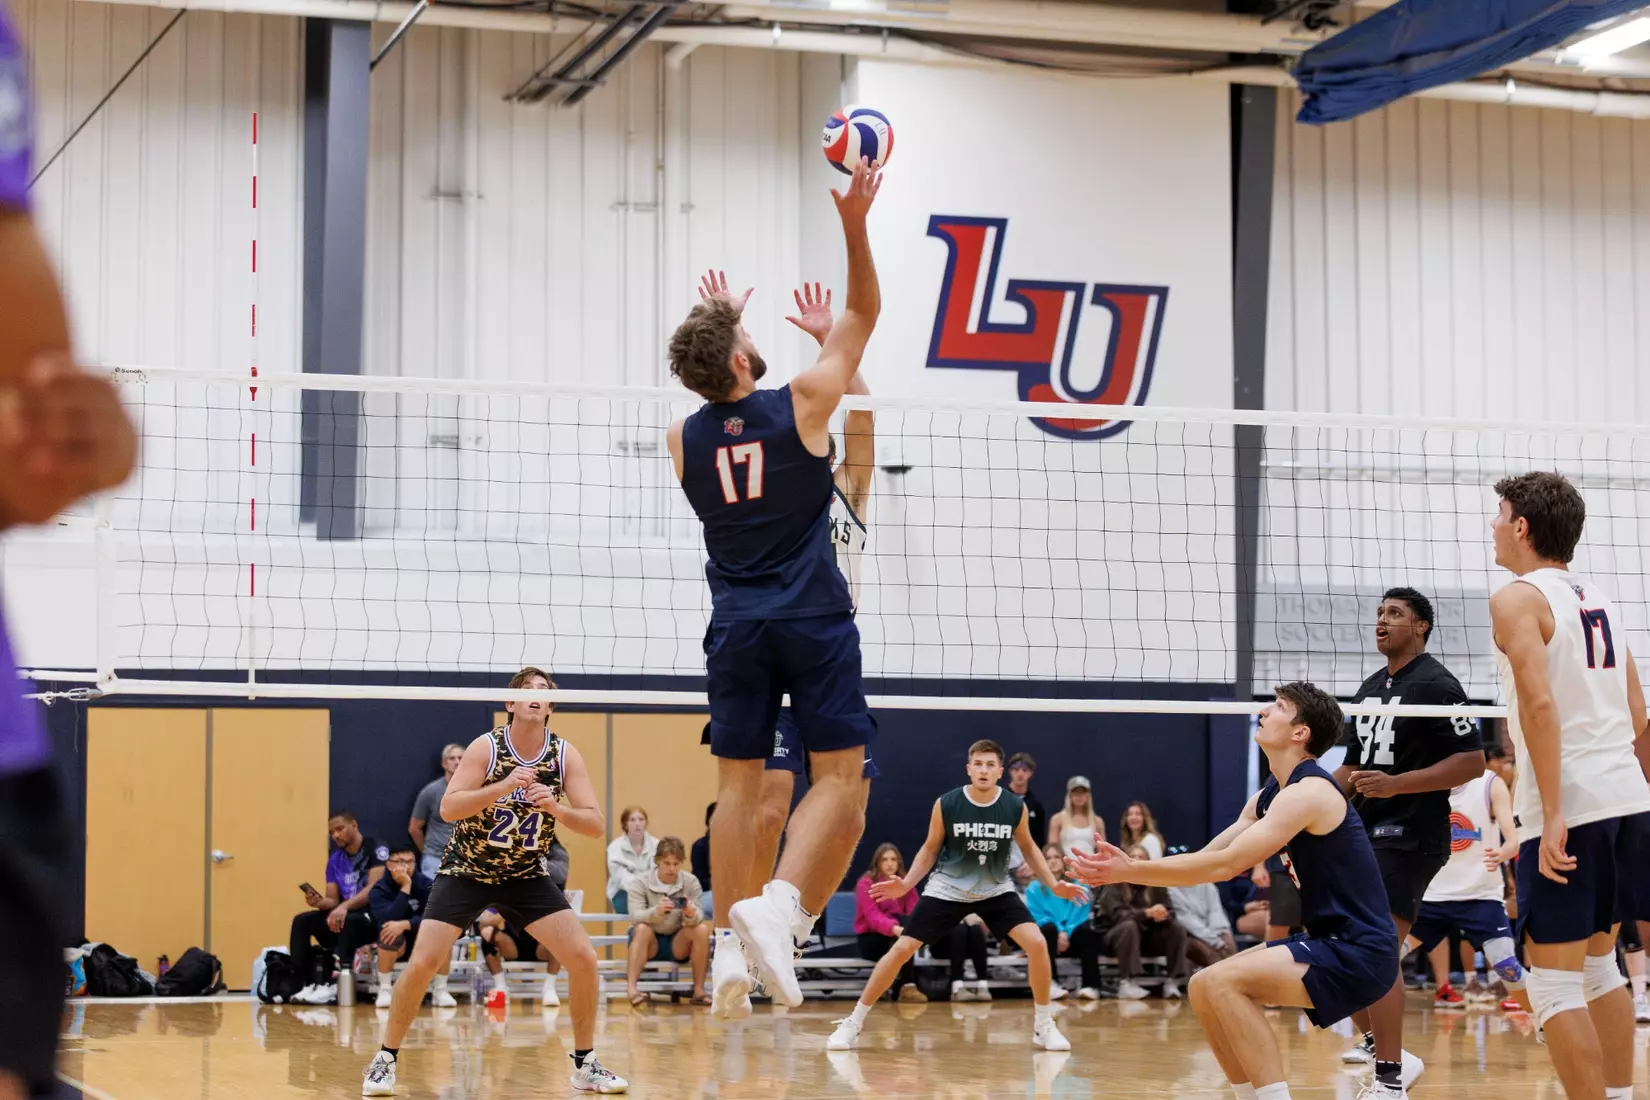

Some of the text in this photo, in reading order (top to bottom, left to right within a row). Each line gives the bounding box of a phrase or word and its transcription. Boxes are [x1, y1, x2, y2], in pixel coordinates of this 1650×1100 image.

[925, 214, 1169, 440] LU
[715, 440, 764, 504] 17
[1278, 595, 1369, 618] THOMAS
[1279, 623, 1369, 643] SOCCER
[1578, 607, 1616, 669] 17
[1356, 696, 1402, 765] 84
[487, 807, 545, 851] 24
